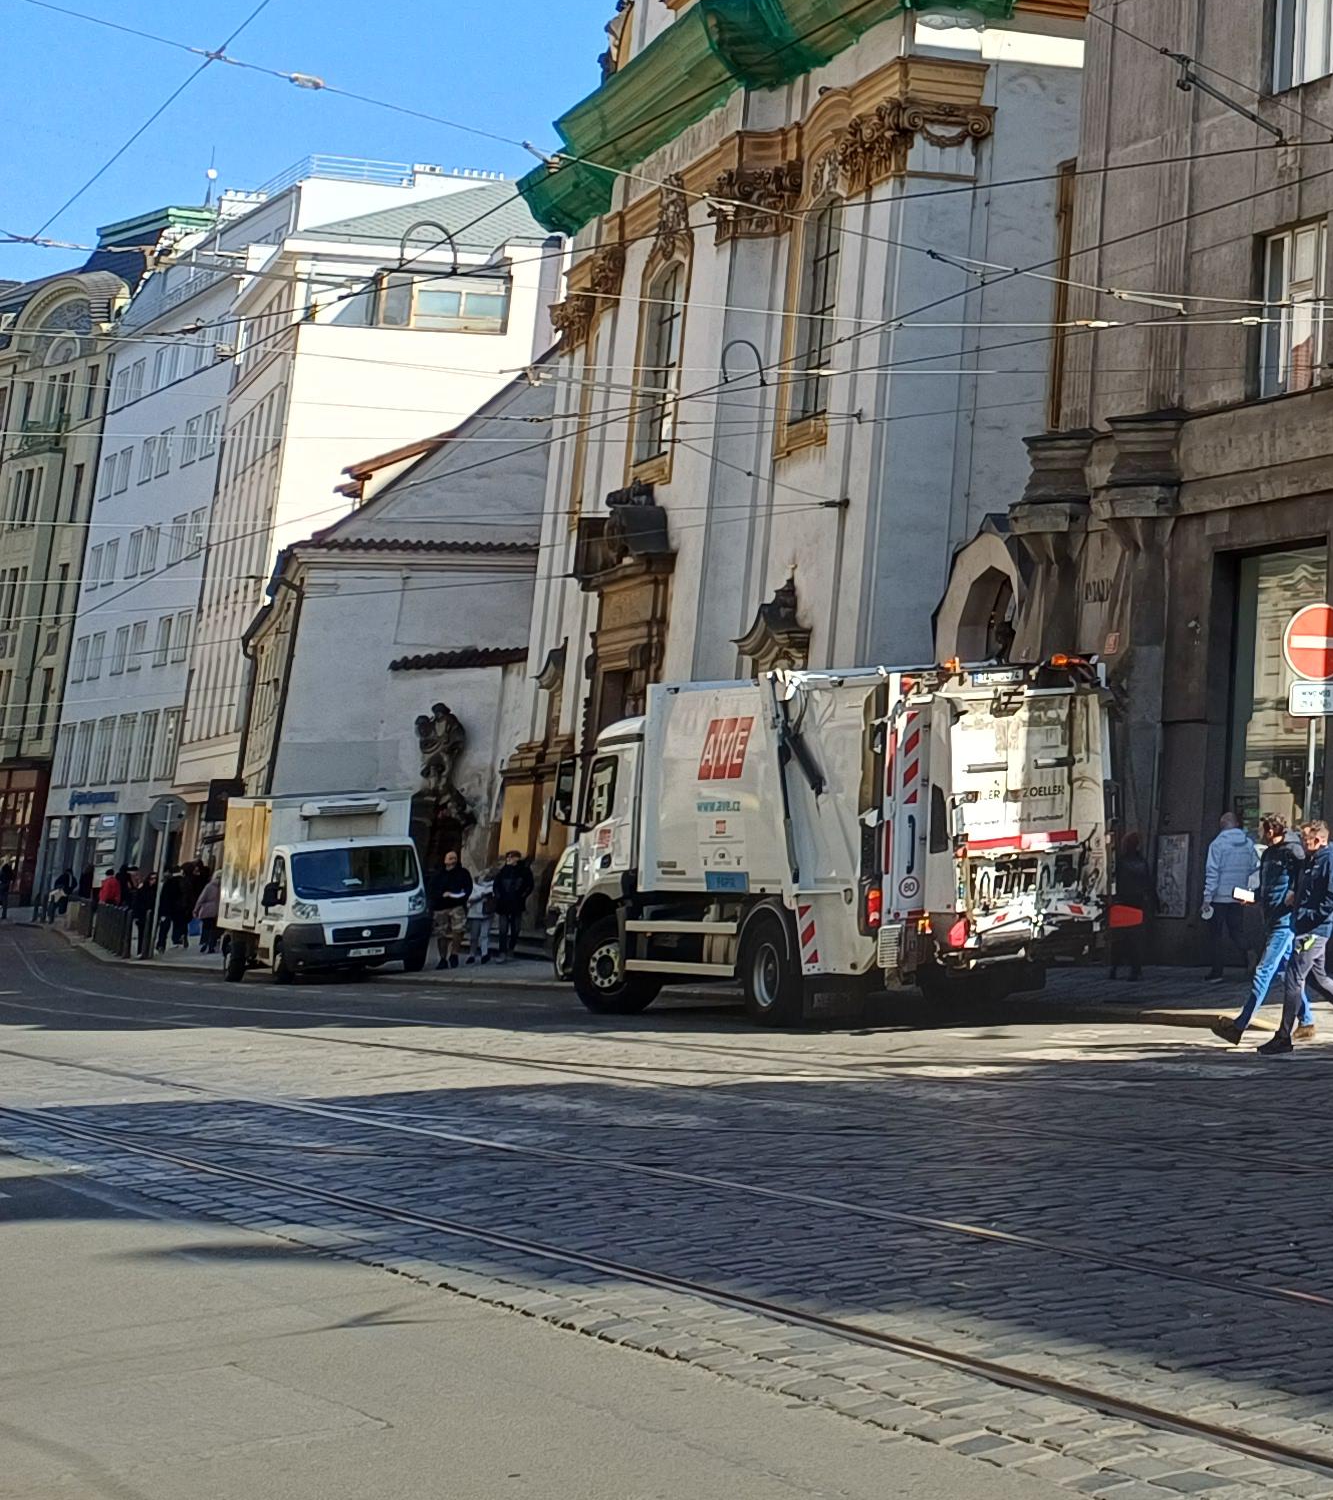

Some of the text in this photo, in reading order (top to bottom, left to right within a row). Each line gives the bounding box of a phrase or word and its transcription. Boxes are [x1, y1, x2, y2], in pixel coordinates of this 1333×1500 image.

[1022, 785, 1065, 798] ZOELLER
[696, 801, 741, 812] www.ave.cz
[903, 881, 916, 893] 80
